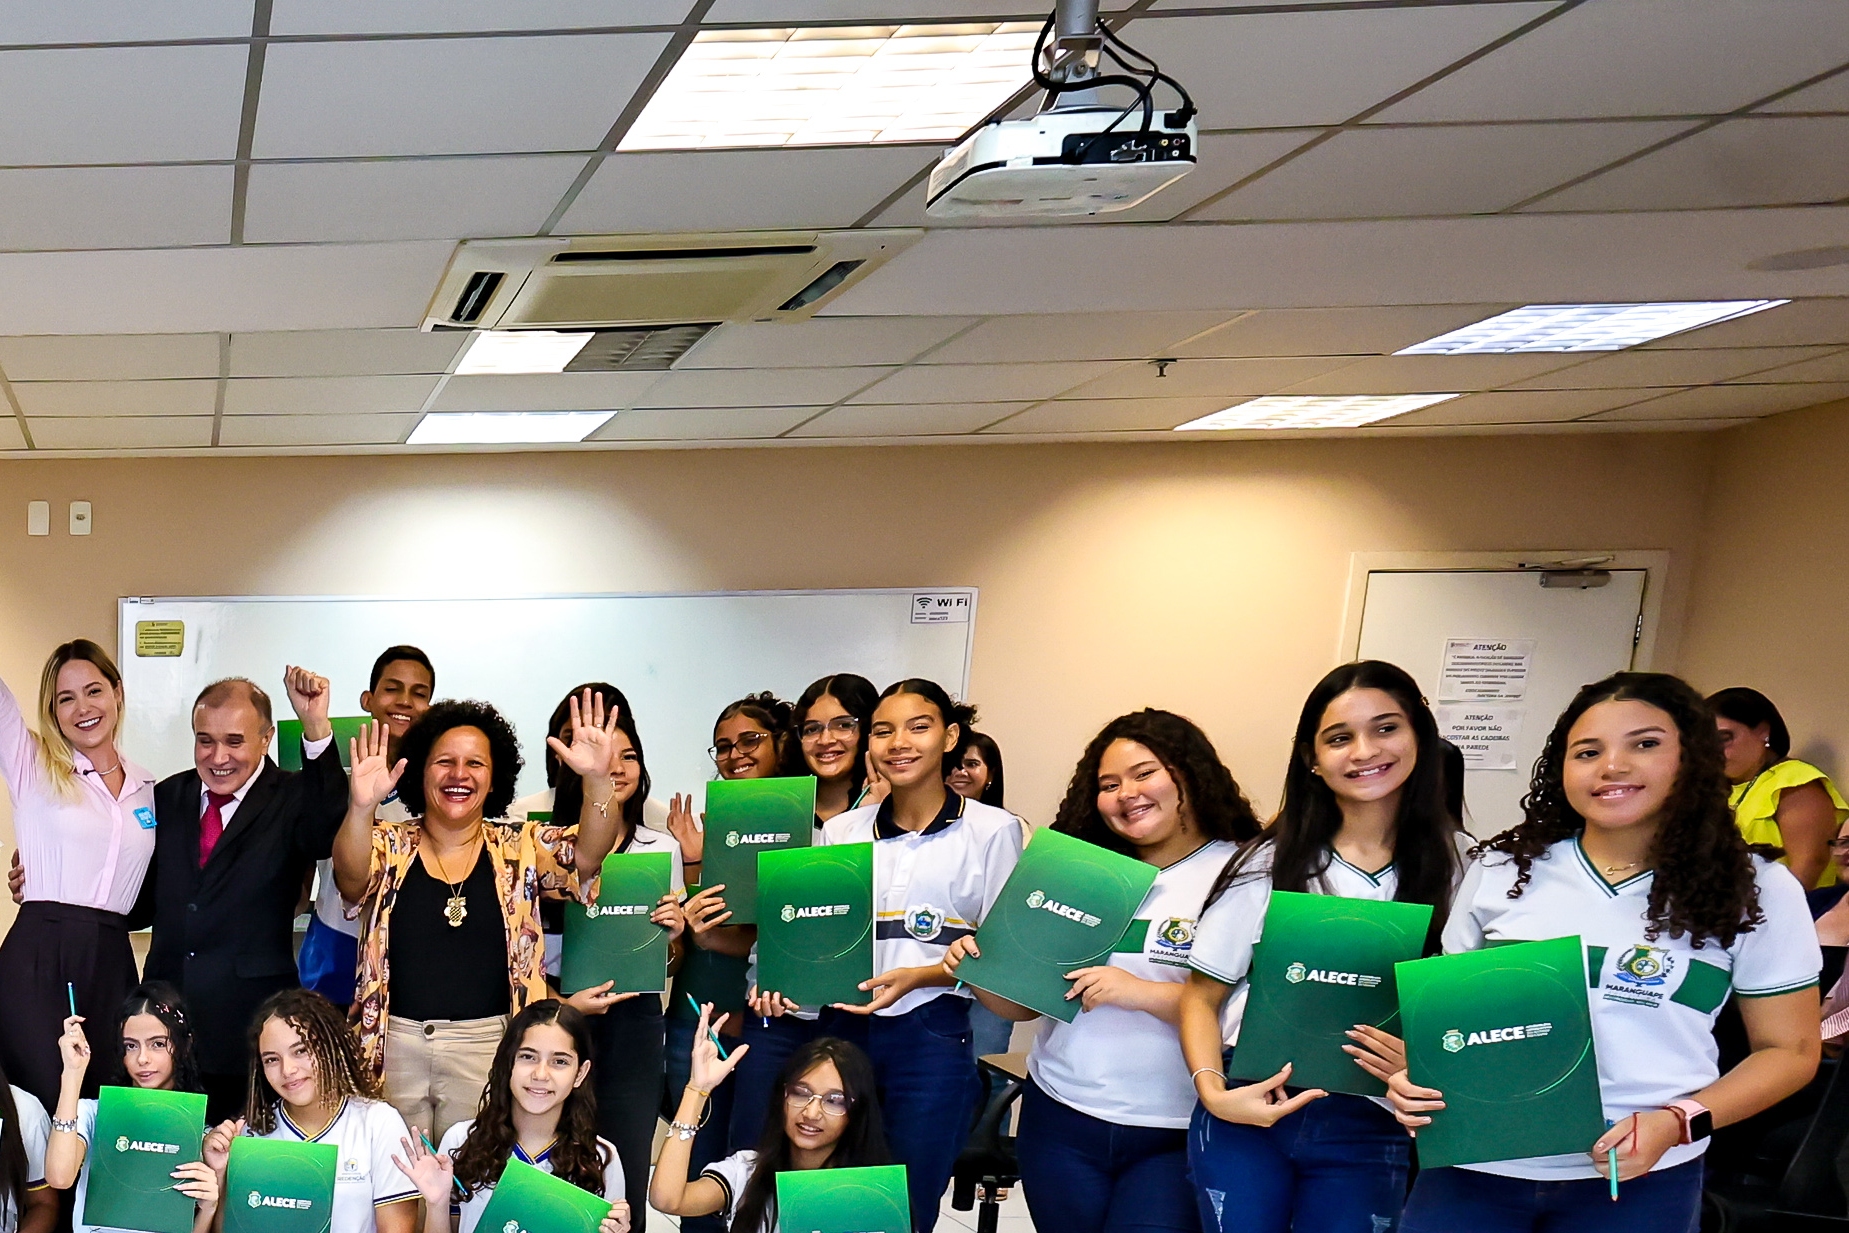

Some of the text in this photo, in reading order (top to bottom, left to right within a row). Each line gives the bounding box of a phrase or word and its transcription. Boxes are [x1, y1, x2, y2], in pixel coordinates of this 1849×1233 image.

[1473, 643, 1507, 652] ATENÇÃO
[740, 833, 775, 844] ALECE
[600, 905, 634, 916] ALECE
[796, 905, 833, 918] ALECE
[1041, 899, 1085, 923] ALECE
[1149, 948, 1189, 960] MARANGUA
[1305, 969, 1359, 986] ALECE
[1605, 984, 1664, 999] MARANGUAPE
[1466, 1025, 1526, 1046] ALECE
[129, 1140, 165, 1153] ALECE
[262, 1195, 297, 1209] ALECE
